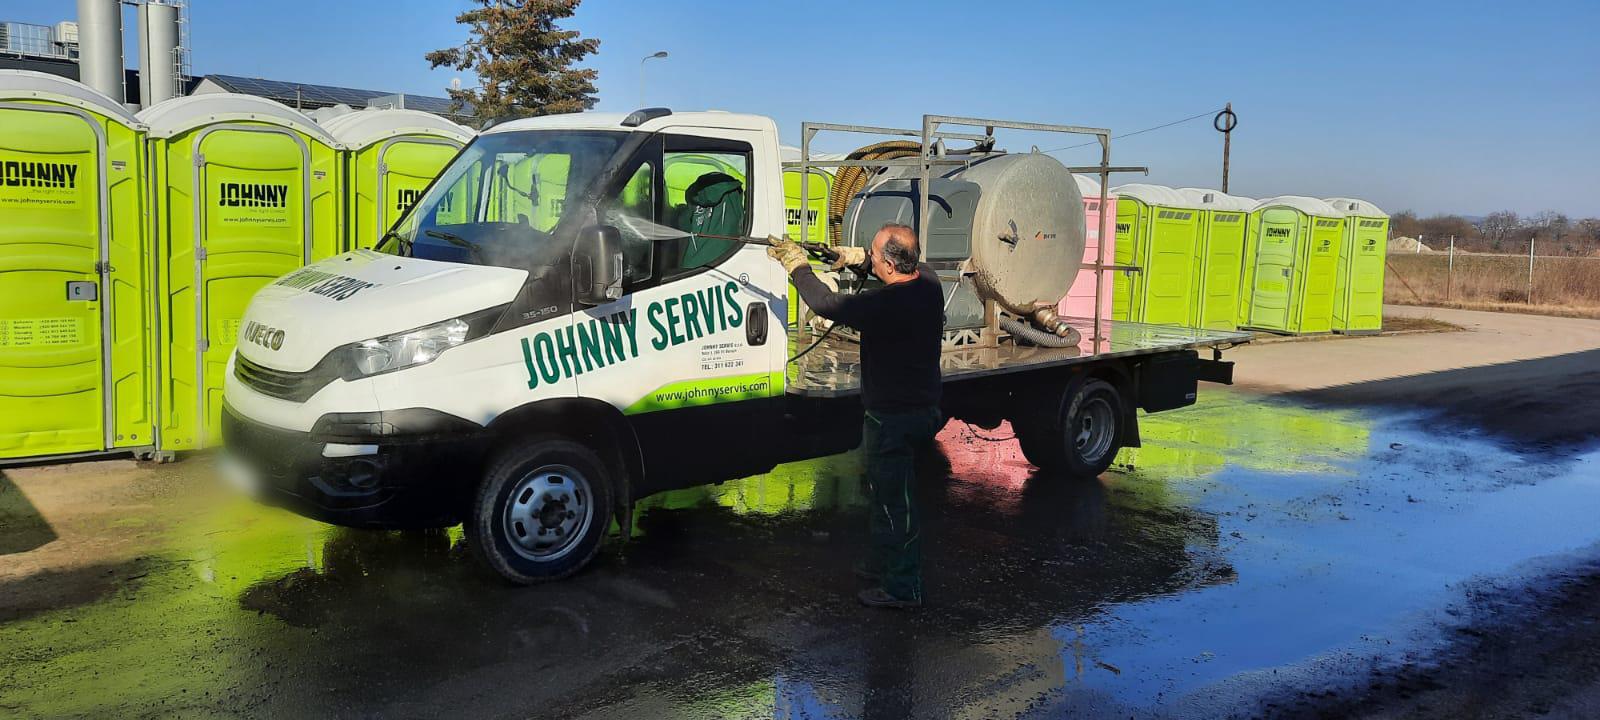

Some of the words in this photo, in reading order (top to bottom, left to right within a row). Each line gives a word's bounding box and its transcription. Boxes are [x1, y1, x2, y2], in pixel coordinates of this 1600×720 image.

[219, 183, 288, 208] JOHNNY
[521, 305, 558, 320] 35-150
[244, 320, 286, 351] IVECO
[520, 307, 640, 390] JOHNNY
[647, 281, 743, 351] SERVIS
[655, 381, 768, 402] www.johnnyservis.com
